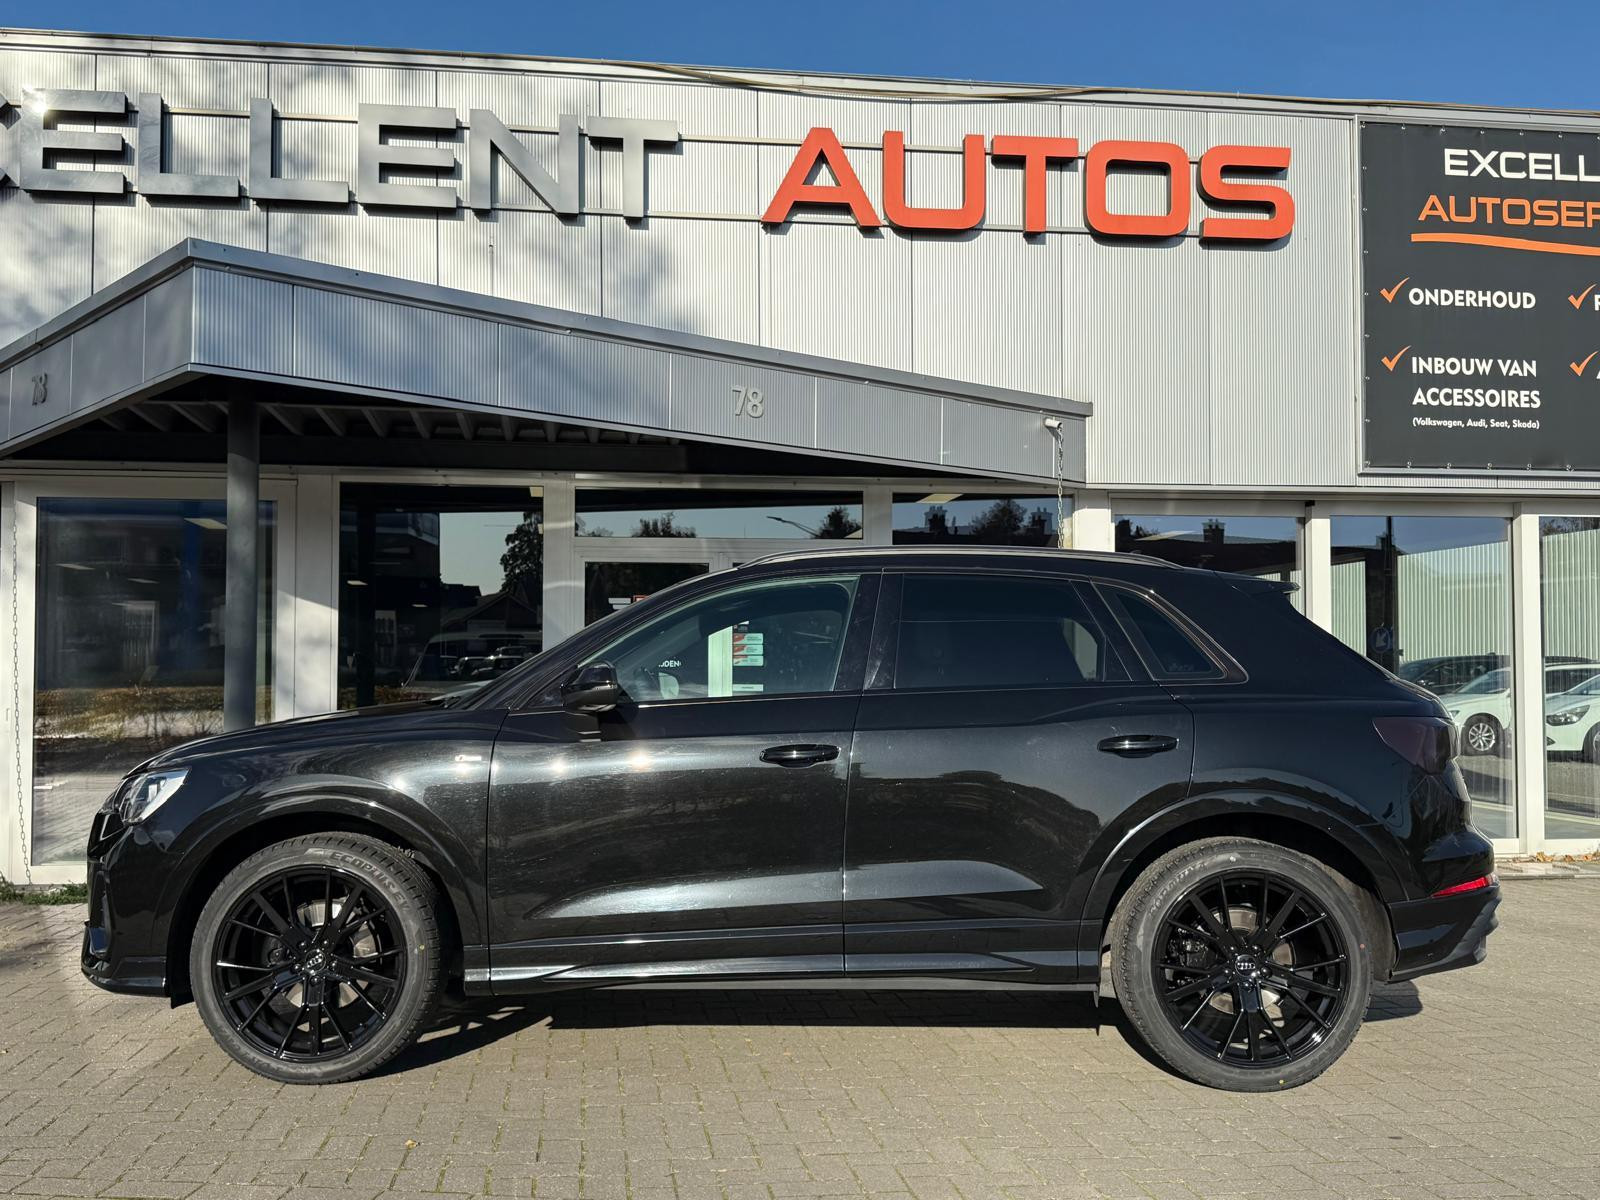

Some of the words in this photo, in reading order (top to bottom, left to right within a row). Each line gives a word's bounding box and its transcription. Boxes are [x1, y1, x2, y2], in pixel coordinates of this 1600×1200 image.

[0, 88, 678, 218] ELLENT
[762, 128, 1295, 240] AUTOS
[1408, 287, 1536, 309] ONDERHOUD
[1411, 356, 1494, 376] INBOUW
[1497, 359, 1537, 377] VAN
[731, 385, 764, 418] 78
[1411, 387, 1541, 409] ACCESSOIRES
[1412, 416, 1465, 429] (Volkswagen,
[1466, 417, 1488, 429] Audi,
[1489, 418, 1511, 430] Seat,
[1512, 418, 1540, 430] Skoda)
